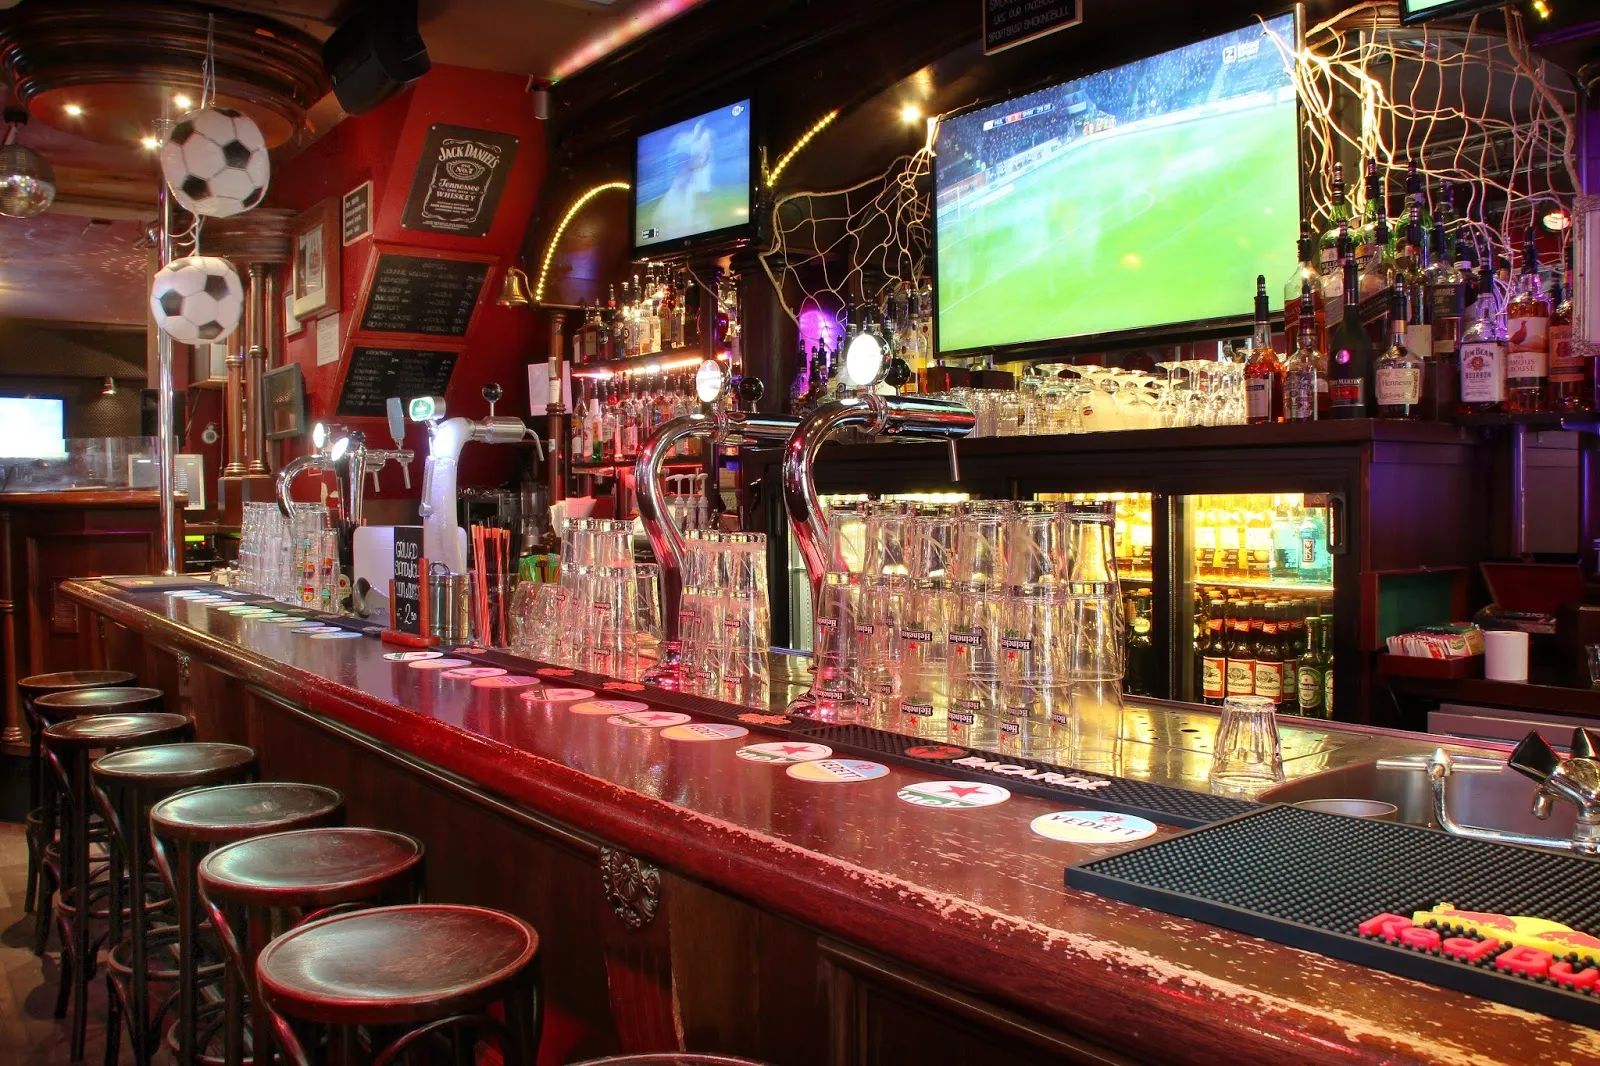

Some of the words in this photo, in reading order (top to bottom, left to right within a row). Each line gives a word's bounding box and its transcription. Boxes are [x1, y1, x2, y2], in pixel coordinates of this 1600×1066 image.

[438, 146, 463, 161] JACK
[465, 143, 500, 169] DANIEL'S
[438, 179, 480, 192] Tennessee
[436, 191, 477, 201] WHISKEY
[1463, 347, 1476, 362] JIM
[1475, 346, 1495, 360] BEAM
[1382, 379, 1412, 388] Hennessy
[1050, 814, 1142, 836] VEDETT
[1358, 912, 1500, 961] Red
[1495, 944, 1600, 995] Bu
